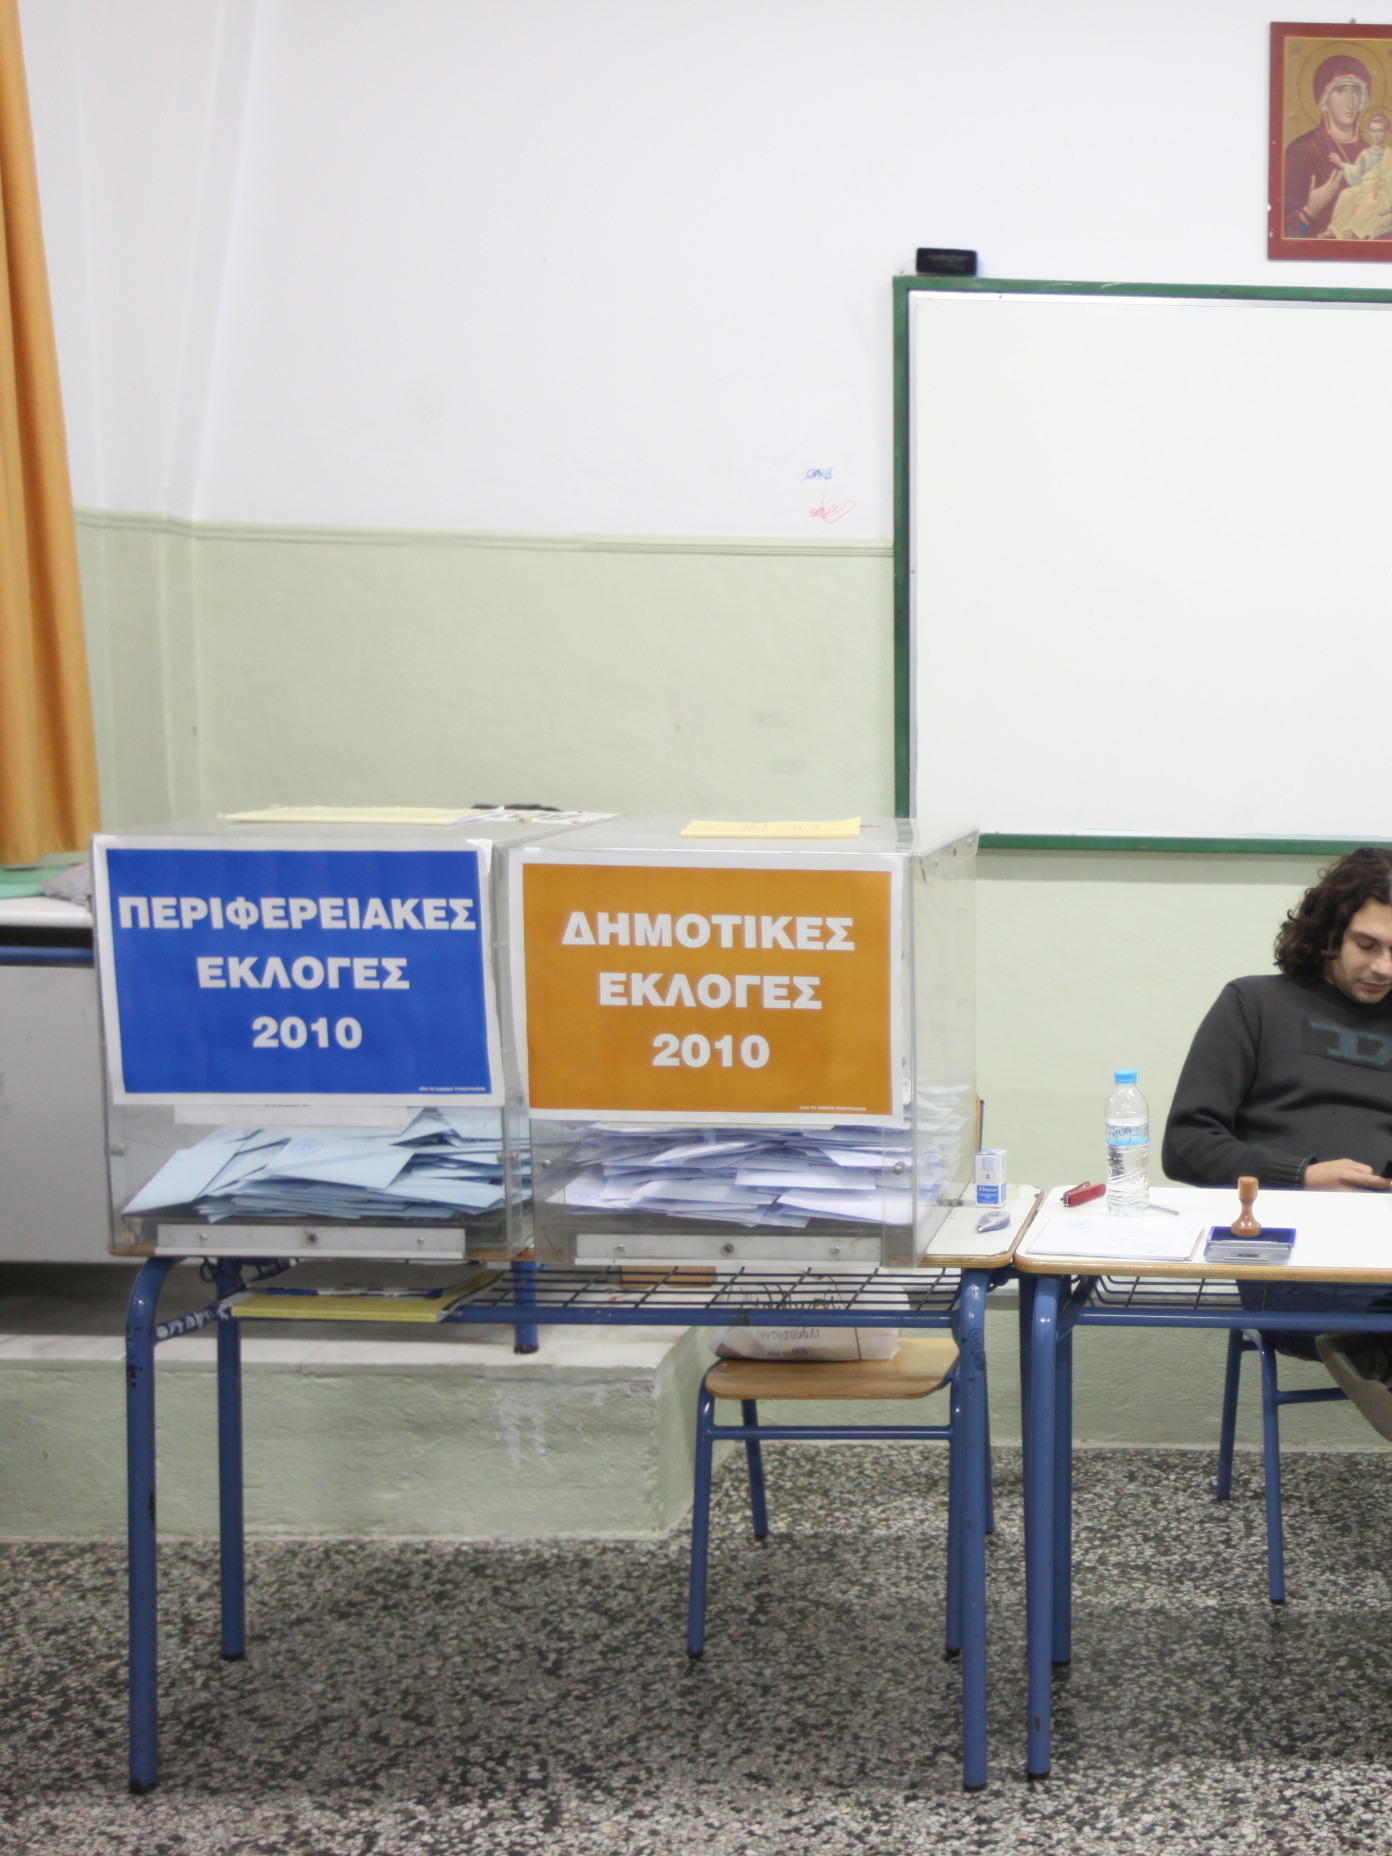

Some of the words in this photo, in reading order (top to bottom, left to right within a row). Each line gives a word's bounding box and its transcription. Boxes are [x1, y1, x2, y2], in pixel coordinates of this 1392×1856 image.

[118, 895, 477, 931] ΠΕΡΙΦΕΡΕΙΑΚΕΣ
[560, 910, 857, 952] ΔΗΜΟΤΙΚΕΣ
[196, 955, 411, 991] ΕΚΛΟΓΕΣ
[597, 971, 824, 1011] ΕΚΛΟΓΕΣ
[251, 1016, 363, 1049] 2010
[651, 1032, 771, 1070] 2010
